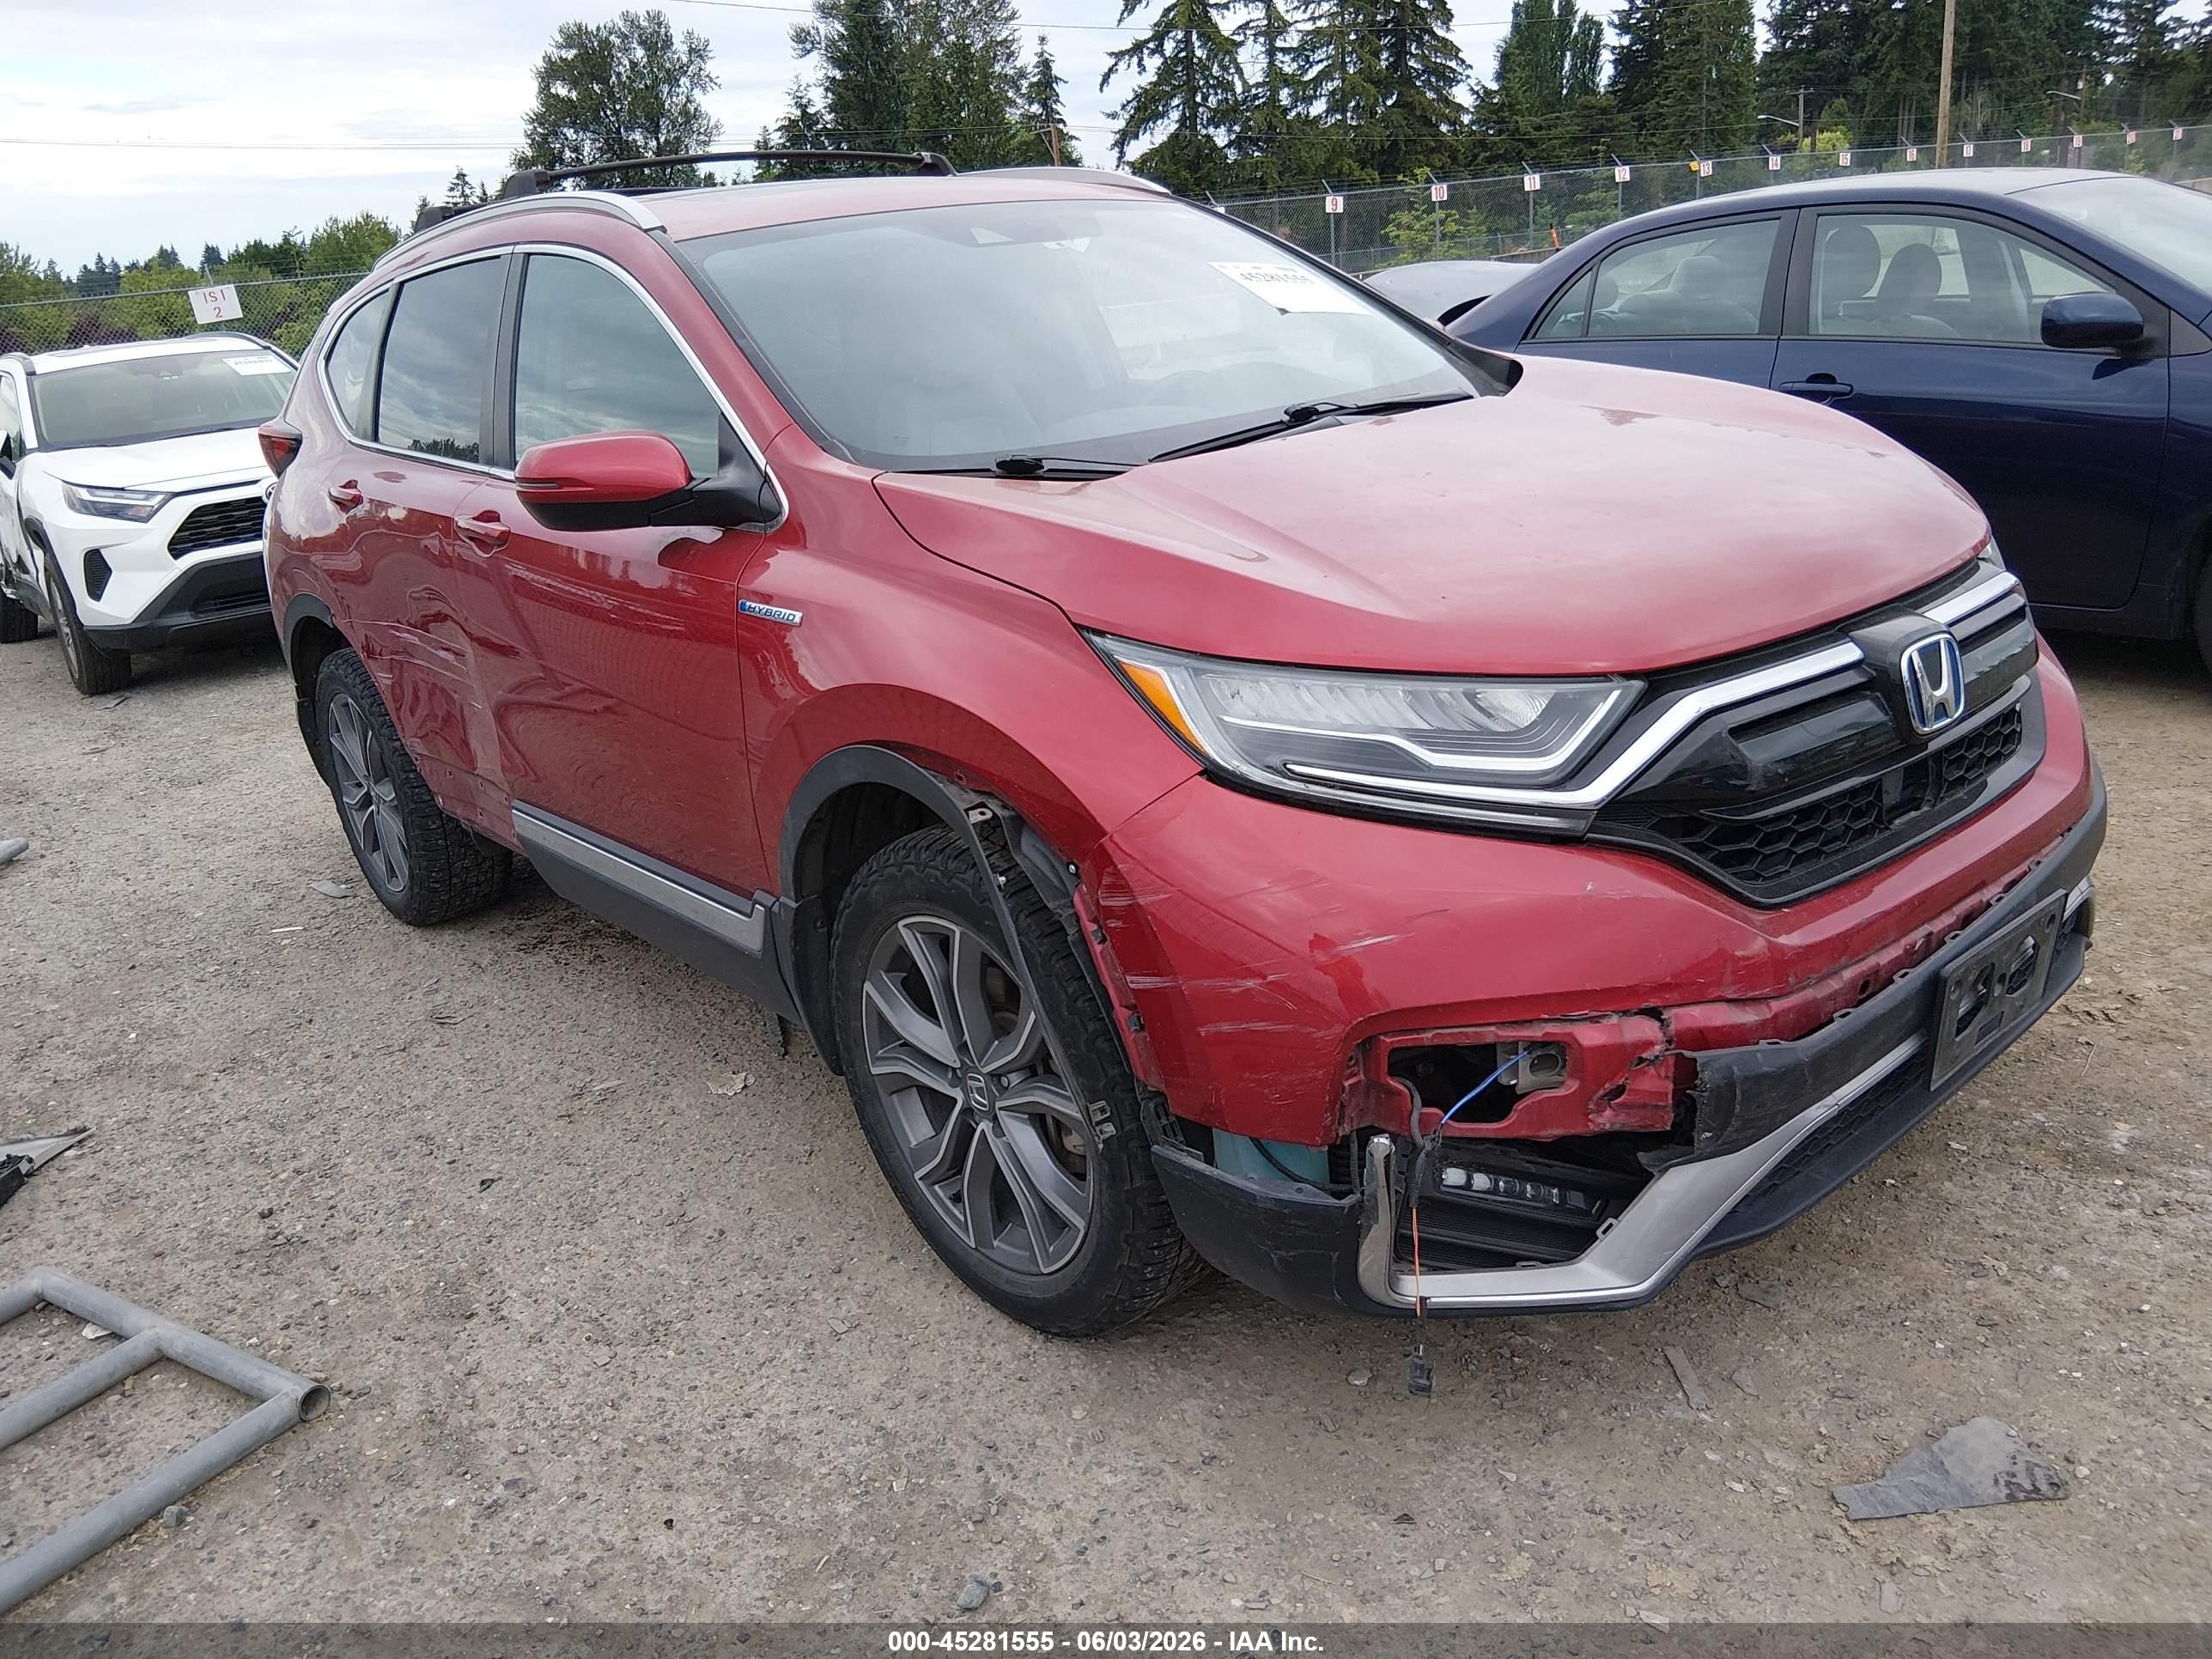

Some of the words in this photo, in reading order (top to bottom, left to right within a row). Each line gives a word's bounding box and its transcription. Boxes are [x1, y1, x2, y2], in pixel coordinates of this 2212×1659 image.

[1964, 145, 1972, 155] 17
[2023, 140, 2030, 151] 18
[1840, 153, 1849, 164] 15
[1908, 149, 1915, 160] 16
[1701, 162, 1711, 175] 13
[1770, 156, 1778, 169] 14
[1617, 167, 1627, 180] 12
[1528, 176, 1537, 190] 11
[1433, 185, 1445, 200] 10
[1331, 197, 1338, 212] 9
[213, 306, 223, 318] 2
[747, 604, 796, 622] HYBRID
